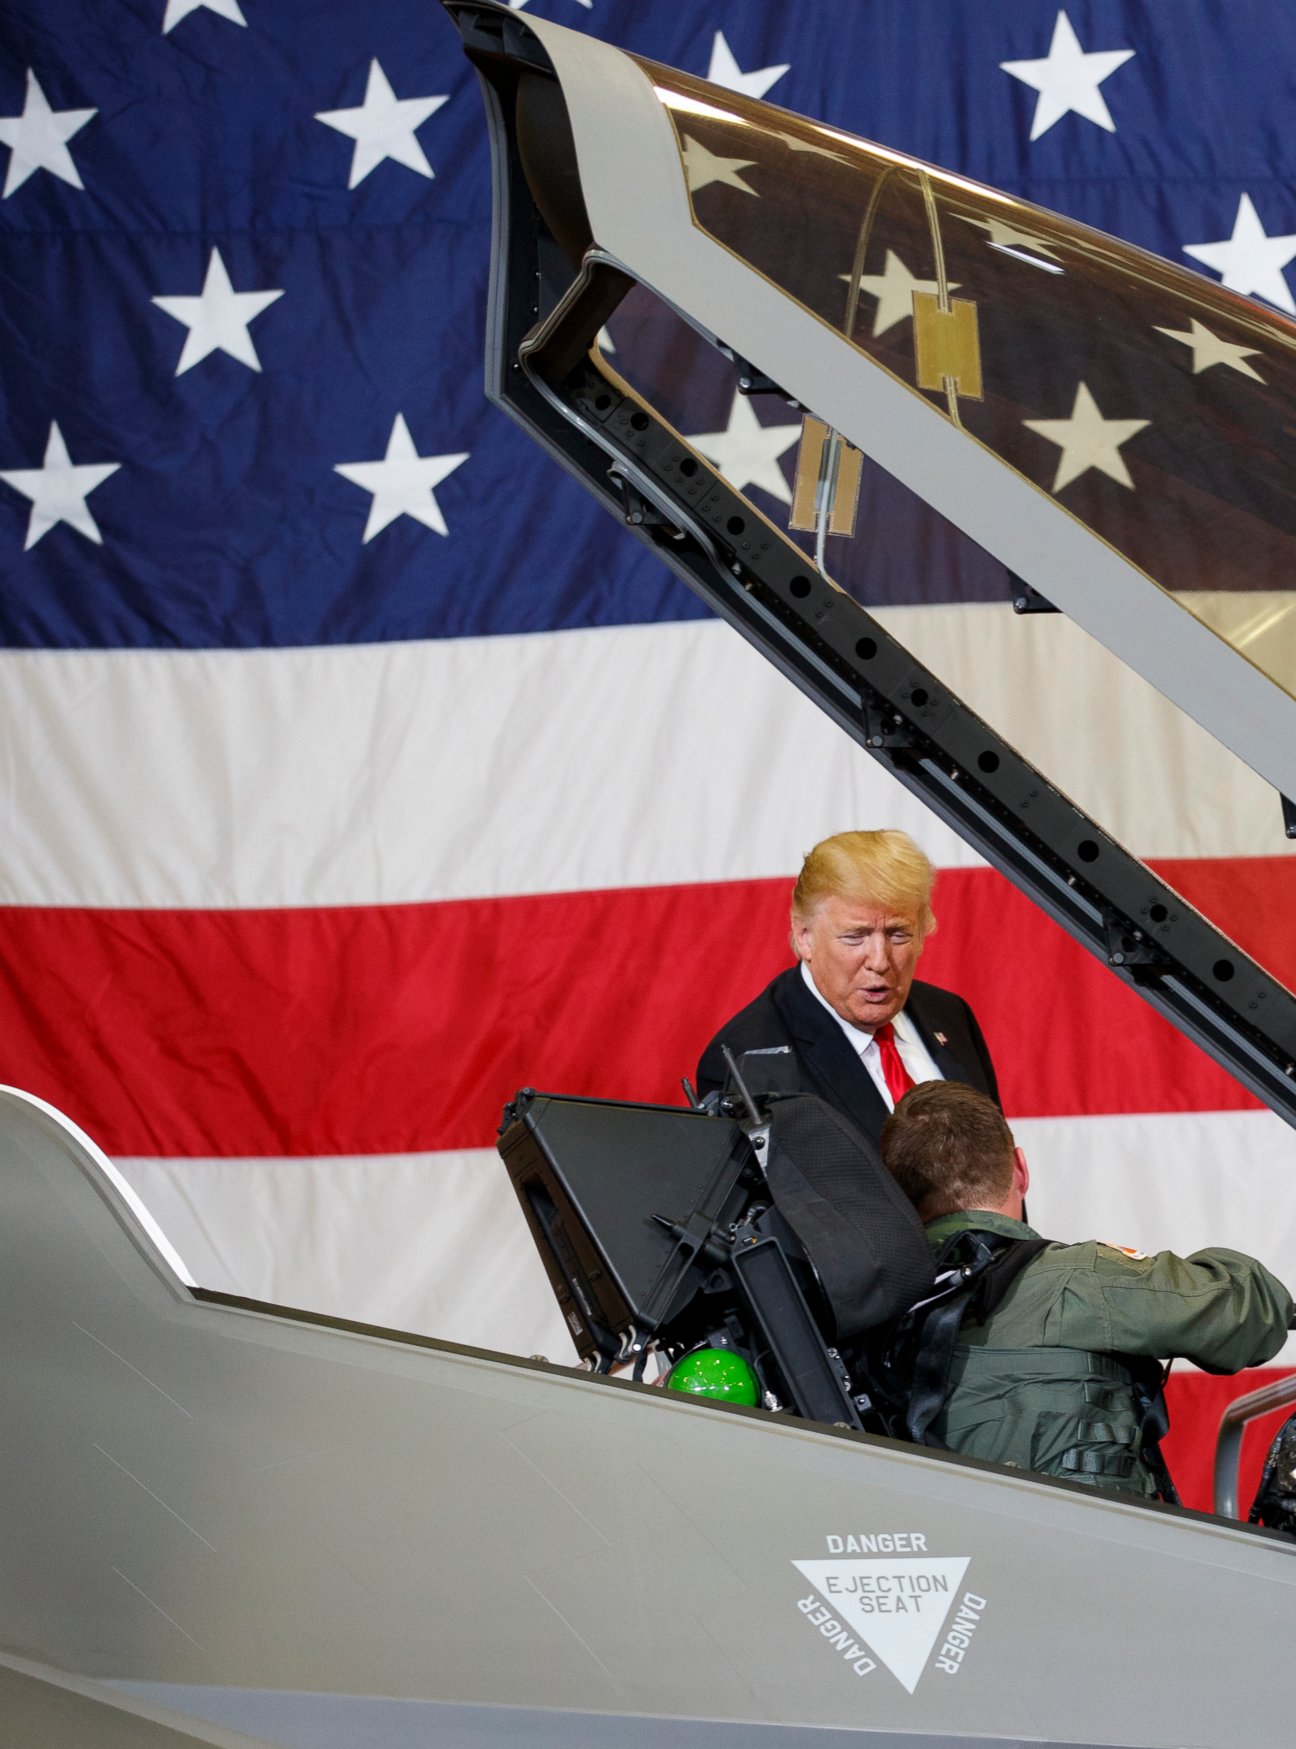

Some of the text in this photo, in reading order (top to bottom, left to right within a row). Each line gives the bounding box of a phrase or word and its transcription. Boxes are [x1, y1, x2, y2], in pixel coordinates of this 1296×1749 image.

[826, 1533, 928, 1553] DANGER
[825, 1575, 949, 1593] EJECTION
[859, 1595, 922, 1613] SEAT
[797, 1594, 877, 1676] DANGER
[935, 1592, 987, 1674] DANGER
